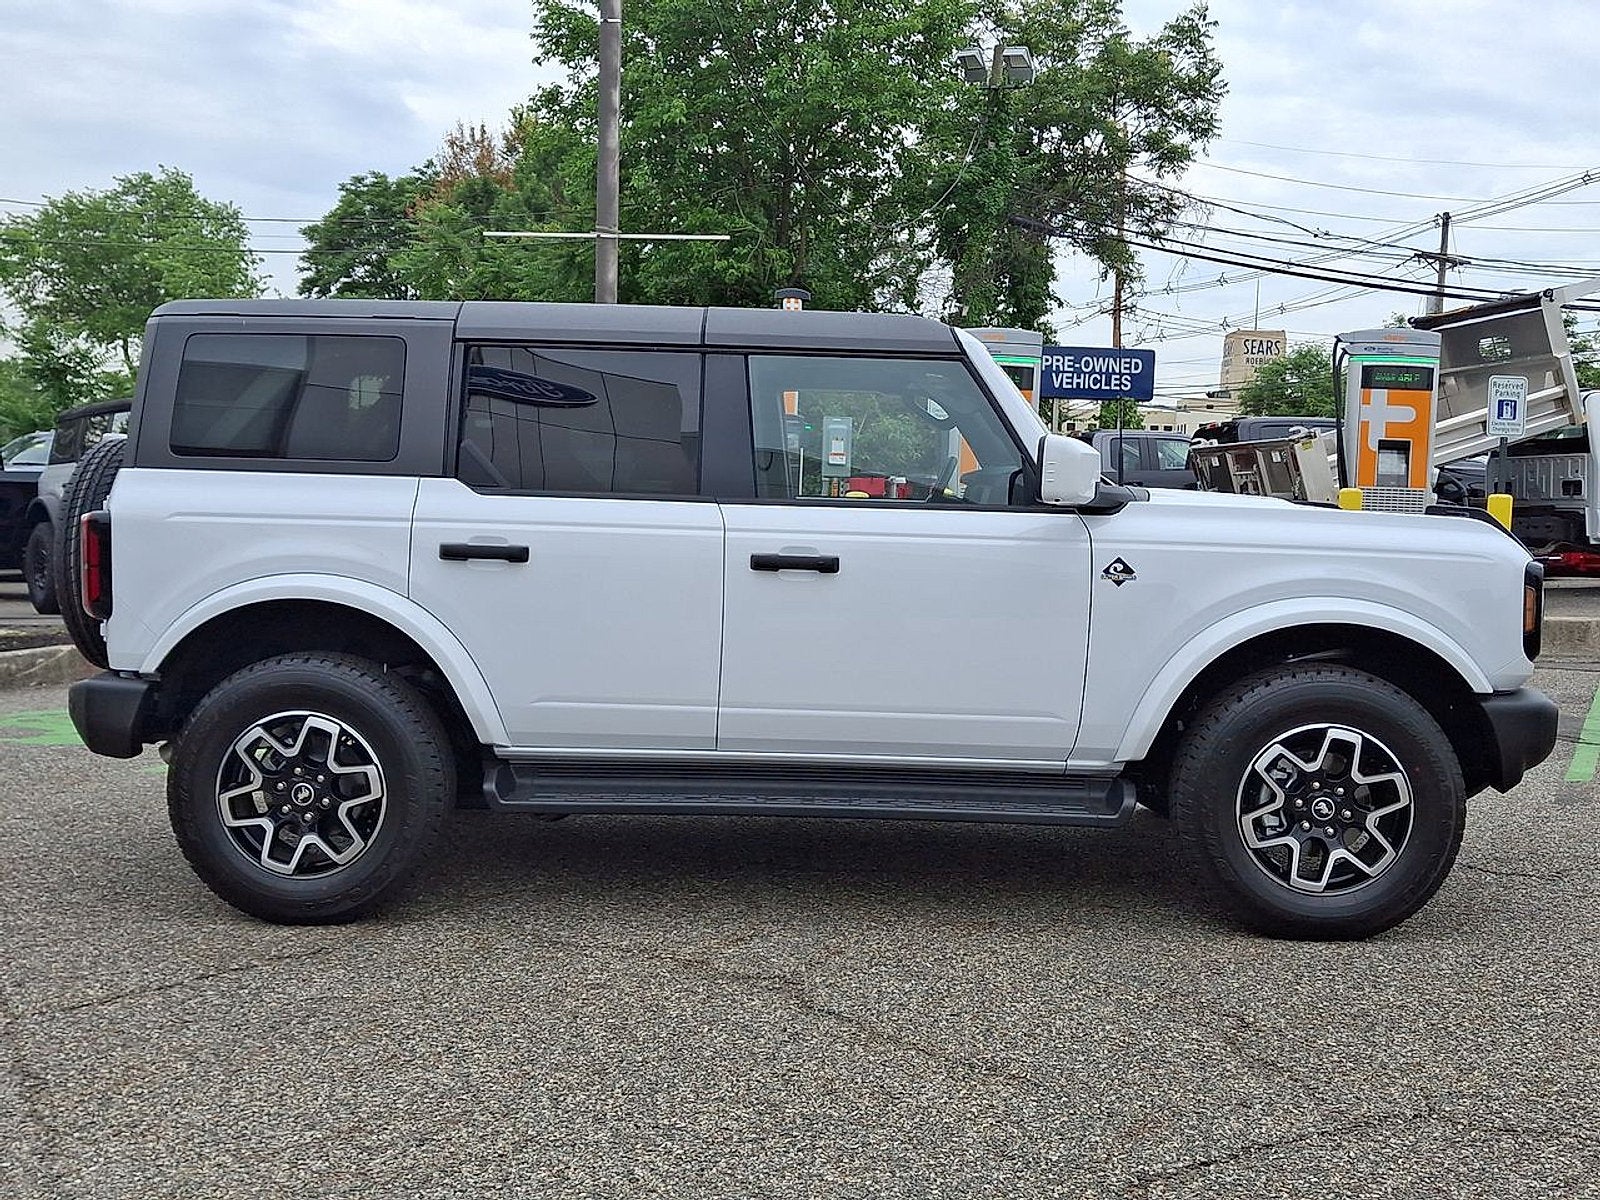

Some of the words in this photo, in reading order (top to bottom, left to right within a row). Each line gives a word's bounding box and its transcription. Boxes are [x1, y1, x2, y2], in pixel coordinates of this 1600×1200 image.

[1243, 339, 1281, 356] SEARS
[1042, 355, 1142, 374] PRE-OWNED
[1052, 373, 1131, 391] VEHICLES
[1493, 381, 1524, 390] Reserved
[1495, 389, 1520, 399] Parking
